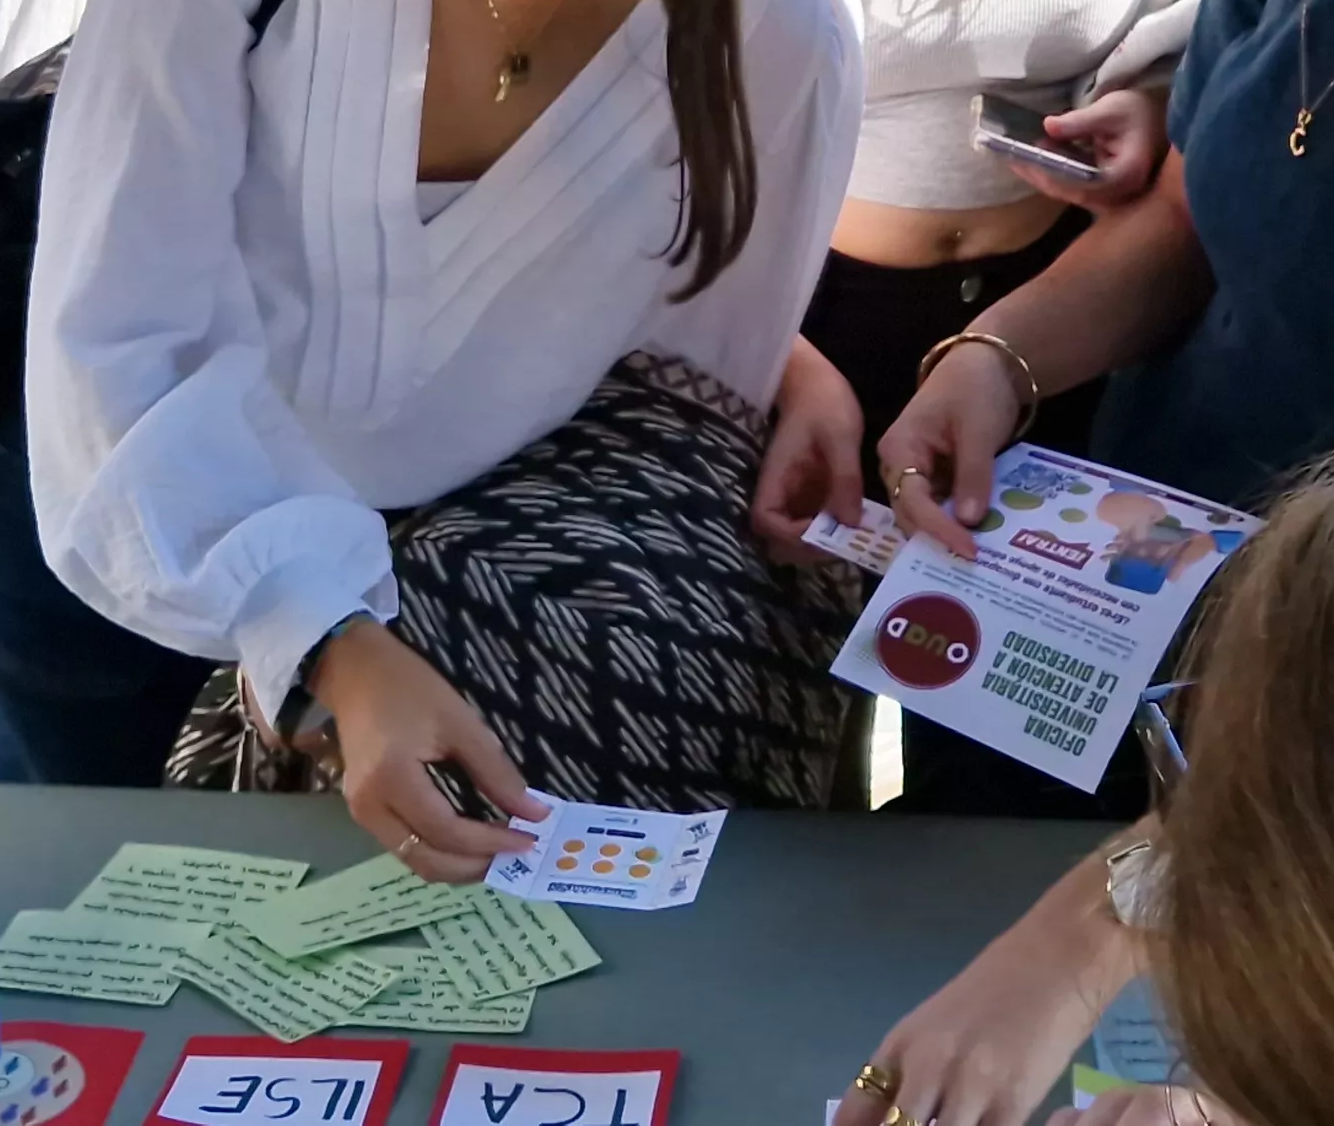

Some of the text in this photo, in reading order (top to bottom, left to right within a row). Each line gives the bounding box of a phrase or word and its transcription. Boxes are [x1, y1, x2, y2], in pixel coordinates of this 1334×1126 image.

[1022, 577, 1041, 588] con
[1042, 569, 1055, 579] de
[1056, 575, 1119, 604] necesidades
[1042, 584, 1098, 612] estudiante
[1120, 600, 1140, 612] con
[1002, 630, 1095, 683] DIVERSIDAD
[992, 650, 1108, 714] DE ATENCIÓN A
[1095, 669, 1119, 693] LA
[981, 671, 1097, 735] UNIVERSITARIA
[1023, 714, 1086, 756] OFICINA
[198, 1074, 365, 1122] ILSE
[481, 1081, 641, 1126] TCA
